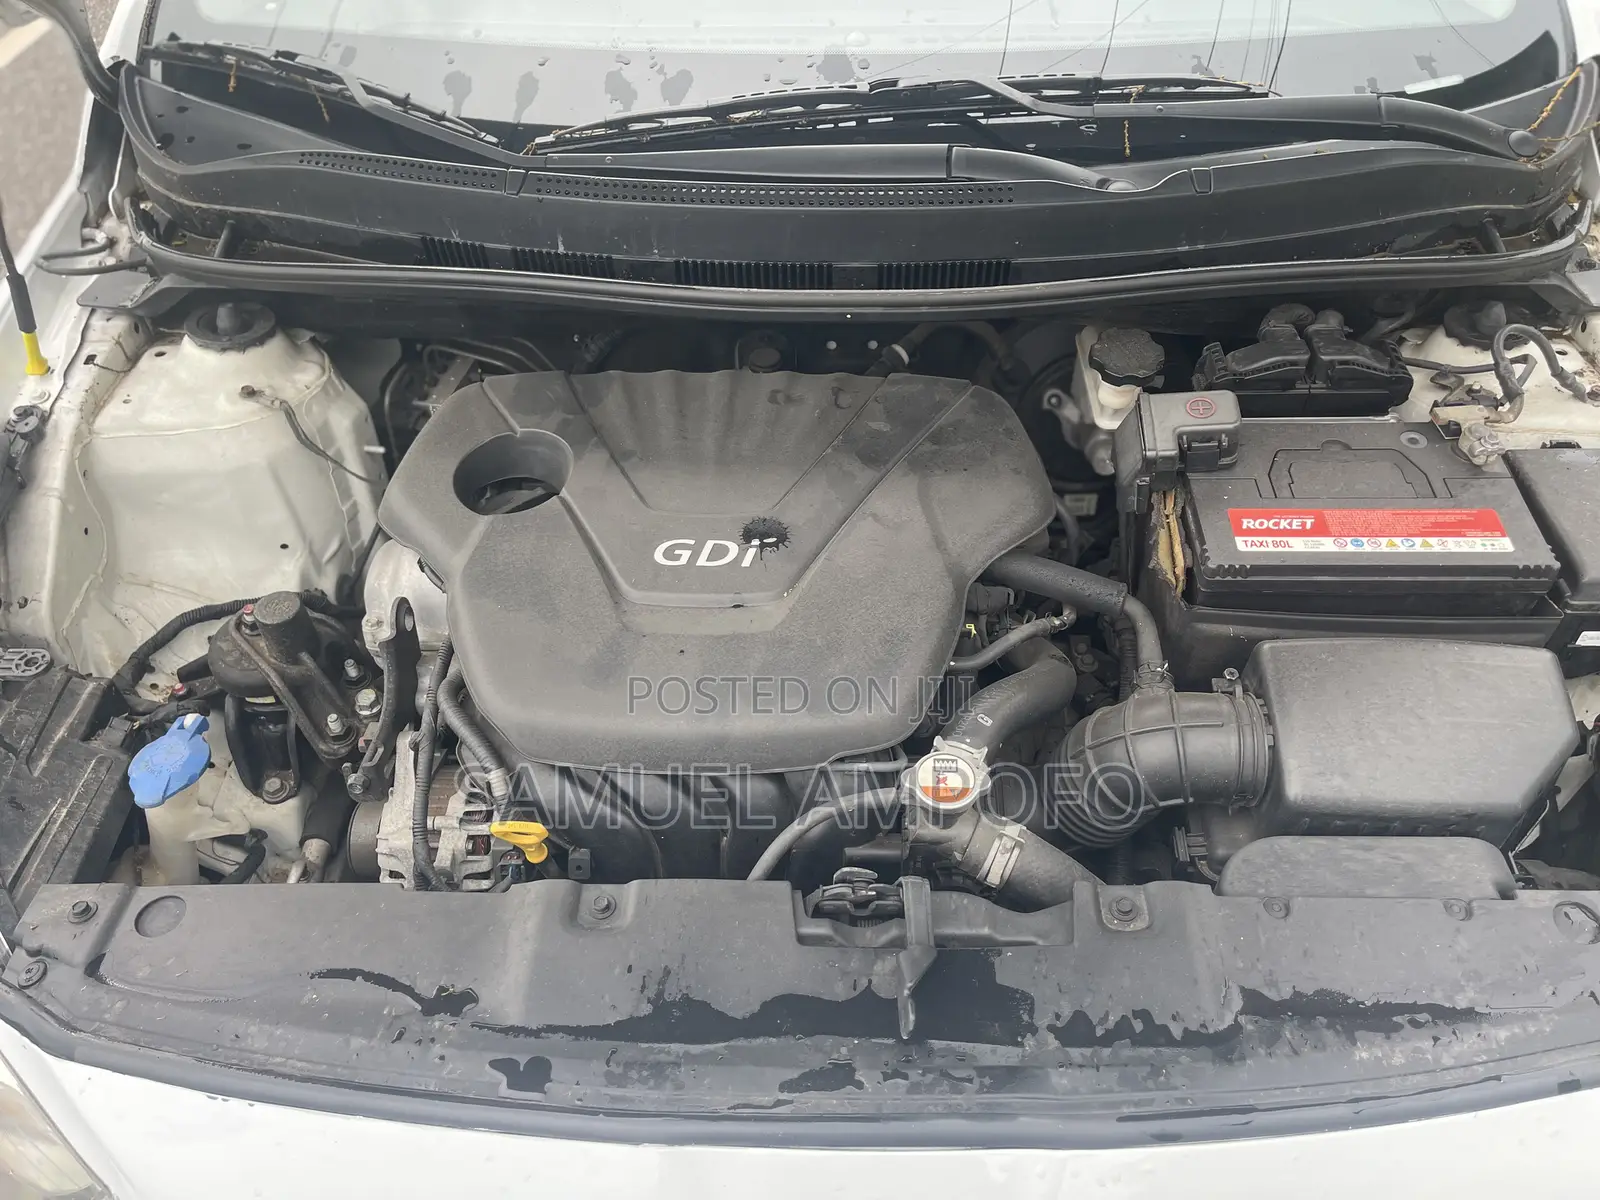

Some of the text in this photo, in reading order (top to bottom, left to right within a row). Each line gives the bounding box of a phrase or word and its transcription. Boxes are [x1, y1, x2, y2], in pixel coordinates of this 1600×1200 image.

[1241, 518, 1315, 530] ROCKET
[1242, 540, 1269, 548] TAXI
[1271, 540, 1294, 548] 80L
[653, 538, 761, 567] GDi
